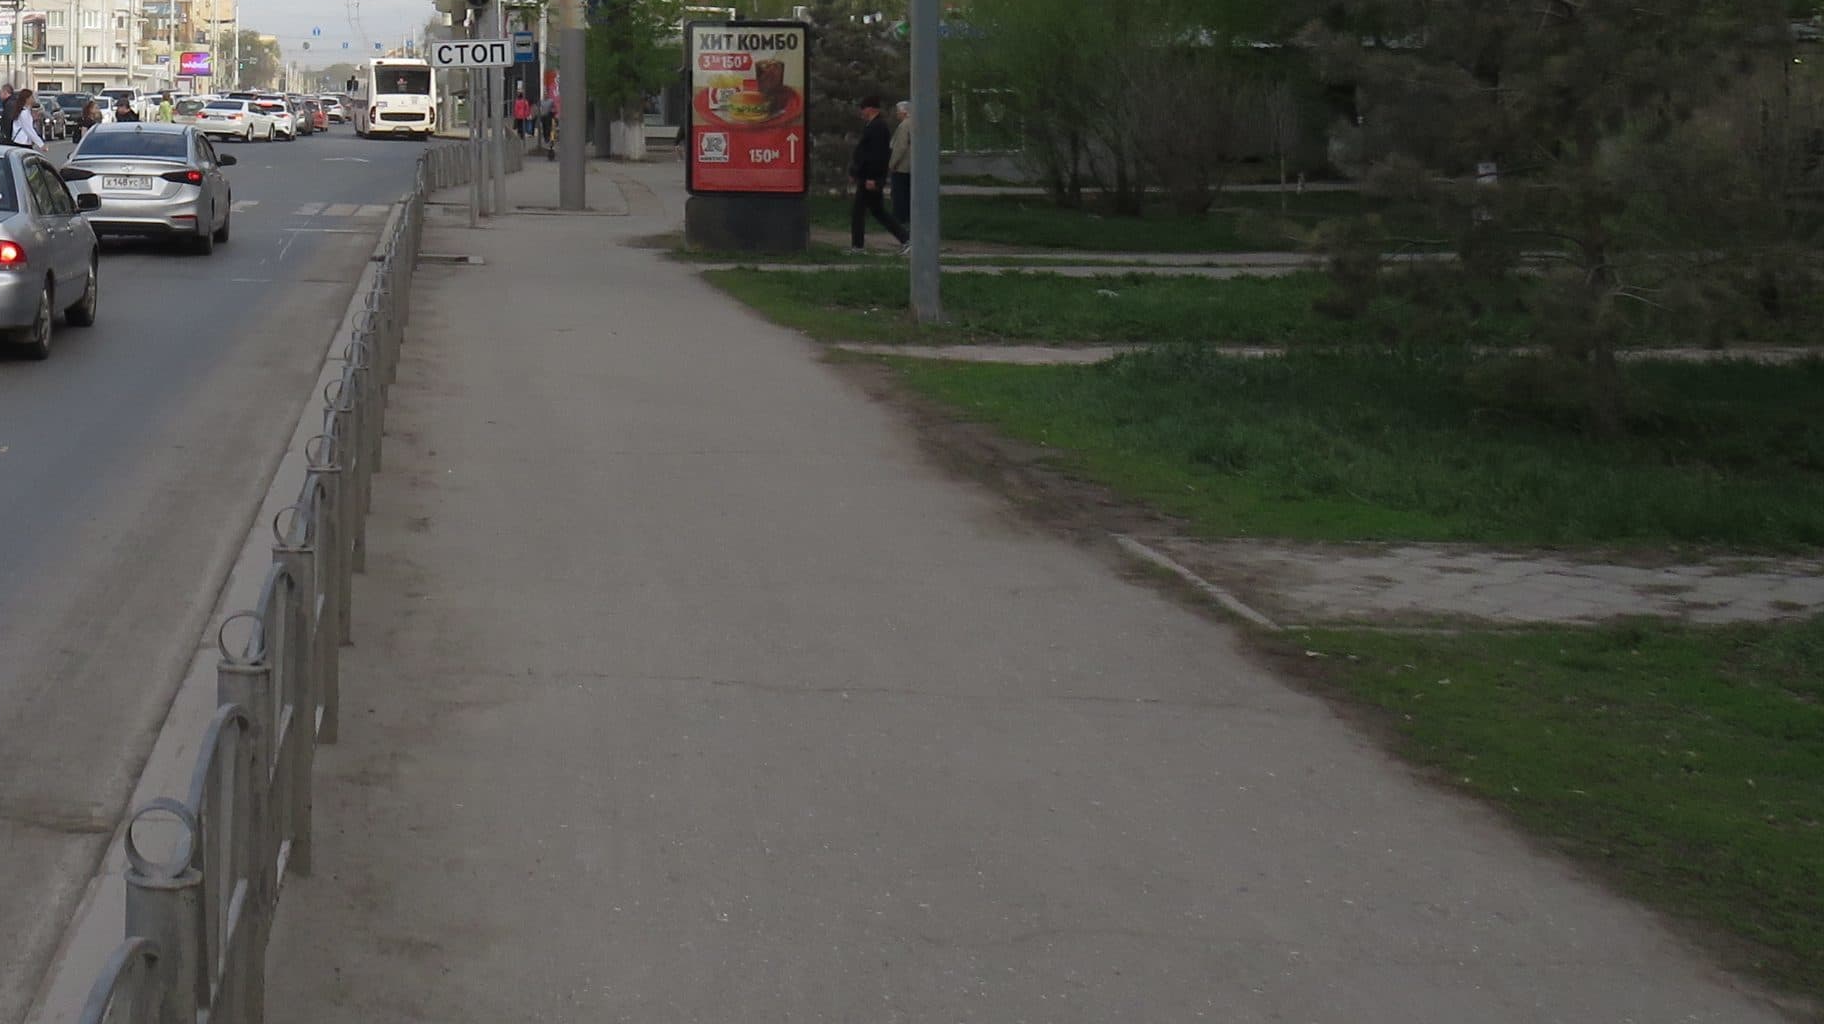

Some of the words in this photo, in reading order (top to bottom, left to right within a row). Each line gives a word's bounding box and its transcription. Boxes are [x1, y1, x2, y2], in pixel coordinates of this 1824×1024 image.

[699, 34, 734, 50] ХИТ
[737, 33, 798, 50] КОМБО
[438, 43, 505, 64] СТОП
